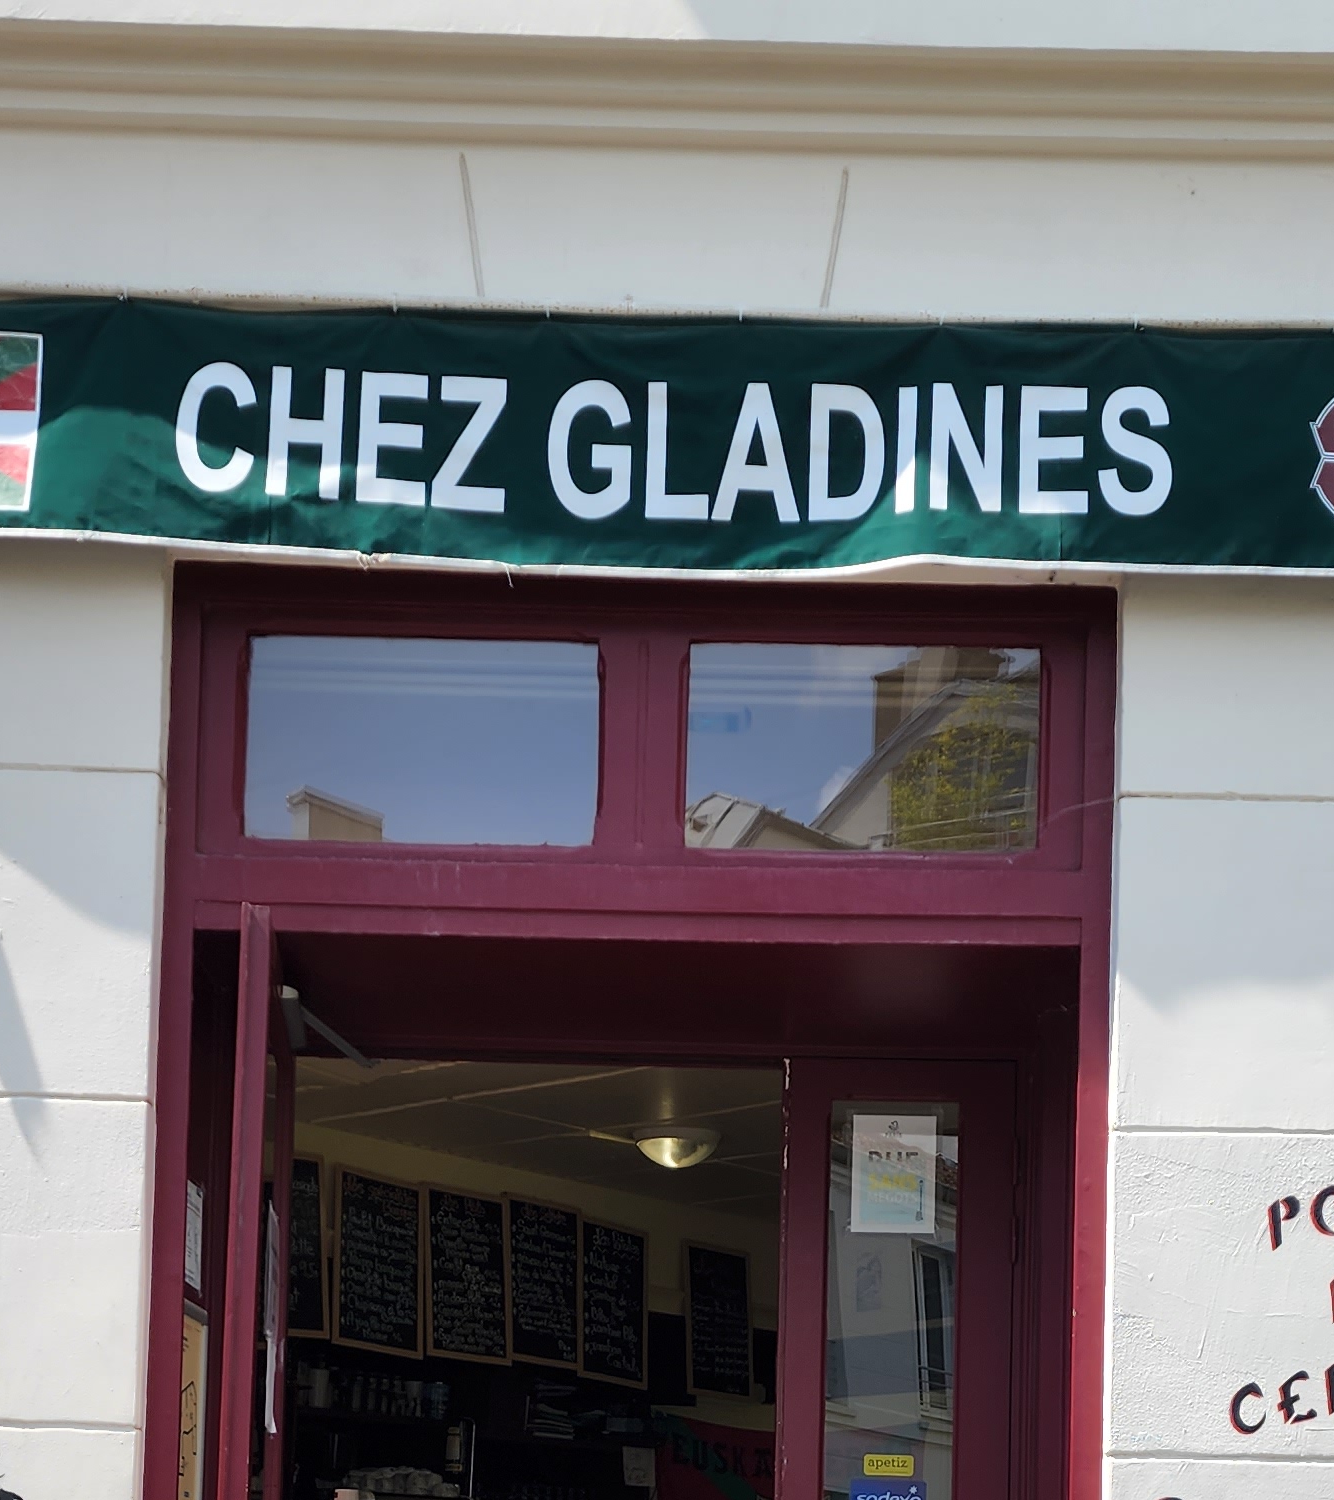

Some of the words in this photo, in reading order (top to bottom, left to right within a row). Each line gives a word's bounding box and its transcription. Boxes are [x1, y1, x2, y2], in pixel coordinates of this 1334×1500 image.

[173, 361, 508, 514] CHEZ
[546, 378, 1175, 523] GLADINES
[867, 1457, 909, 1470] apetiz
